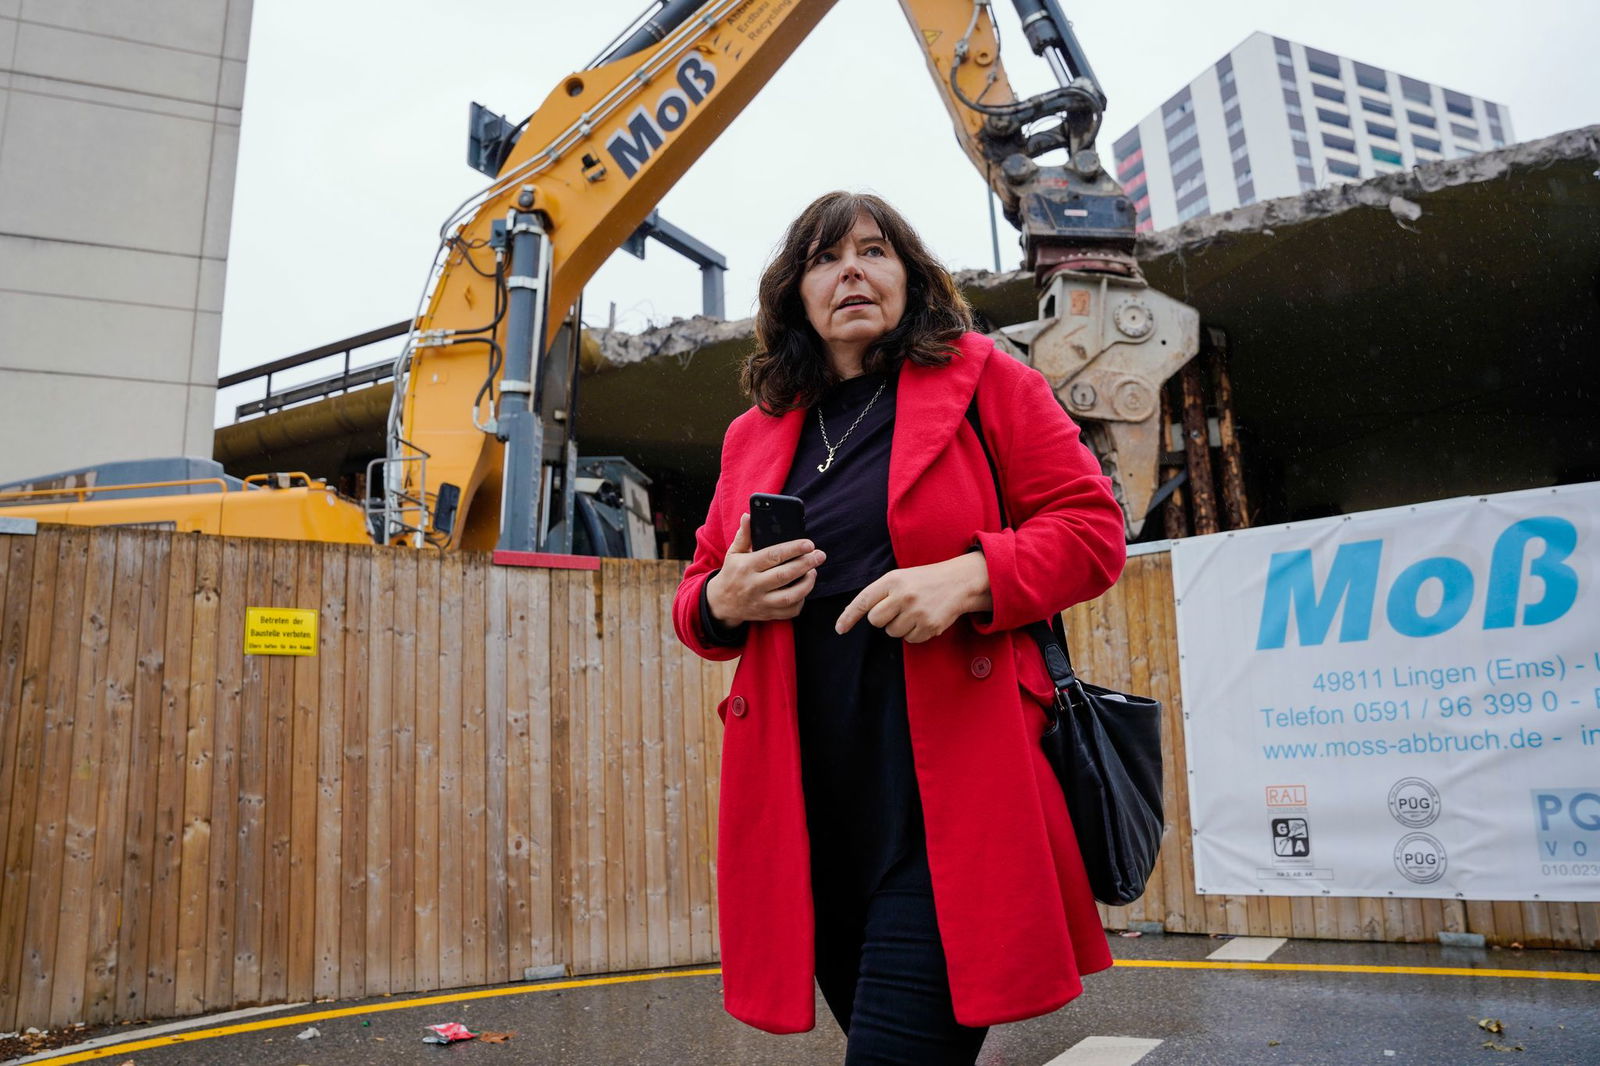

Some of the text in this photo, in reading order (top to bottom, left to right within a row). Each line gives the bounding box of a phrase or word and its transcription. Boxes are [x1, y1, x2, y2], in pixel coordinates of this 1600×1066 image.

[606, 55, 716, 180] Moß
[1255, 516, 1579, 650] Moß
[260, 616, 303, 625] Betreten der
[250, 629, 280, 637] Baustelle
[1312, 668, 1382, 692] 49811
[1393, 665, 1476, 690] Lingen
[1487, 654, 1566, 686] (Ems)
[1260, 705, 1344, 728] Telefon
[1354, 700, 1410, 723] 0591
[1422, 697, 1428, 719] /
[1439, 696, 1472, 718] 96
[1483, 692, 1533, 715] 399
[1542, 690, 1558, 712] 0
[1263, 727, 1543, 760] www.moss-abbruch.de
[1269, 789, 1304, 803] RAL
[1276, 822, 1288, 835] G
[1294, 839, 1306, 852] A
[1542, 864, 1600, 876] 010.023
